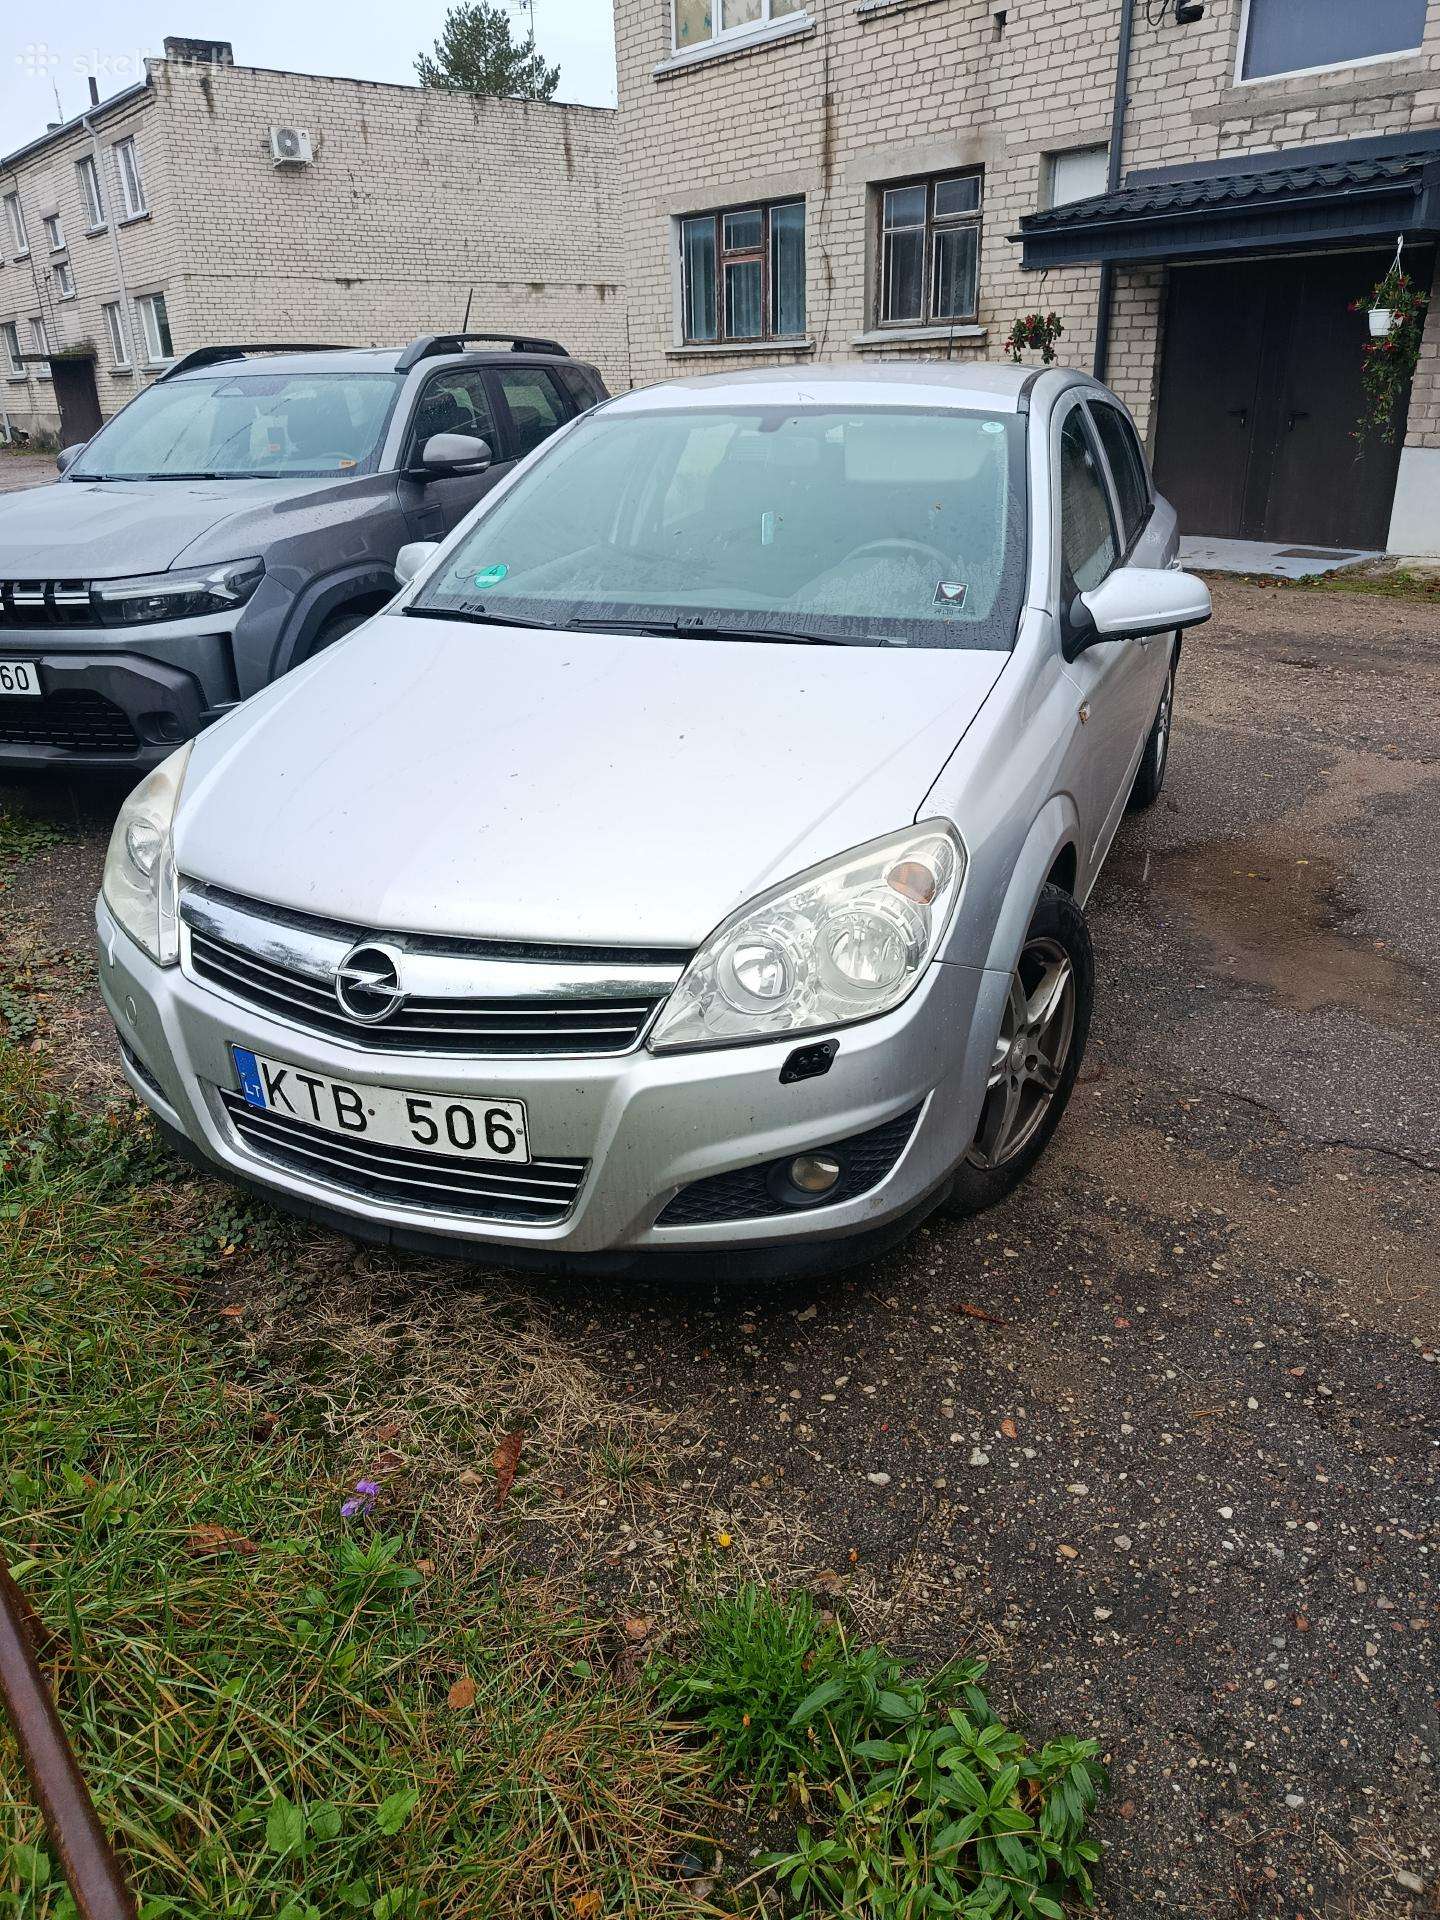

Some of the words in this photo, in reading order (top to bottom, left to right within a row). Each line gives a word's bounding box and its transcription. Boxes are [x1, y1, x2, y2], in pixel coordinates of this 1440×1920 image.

[244, 1081, 260, 1098] LT
[261, 1062, 368, 1132] KTB
[405, 1097, 517, 1154] 506
